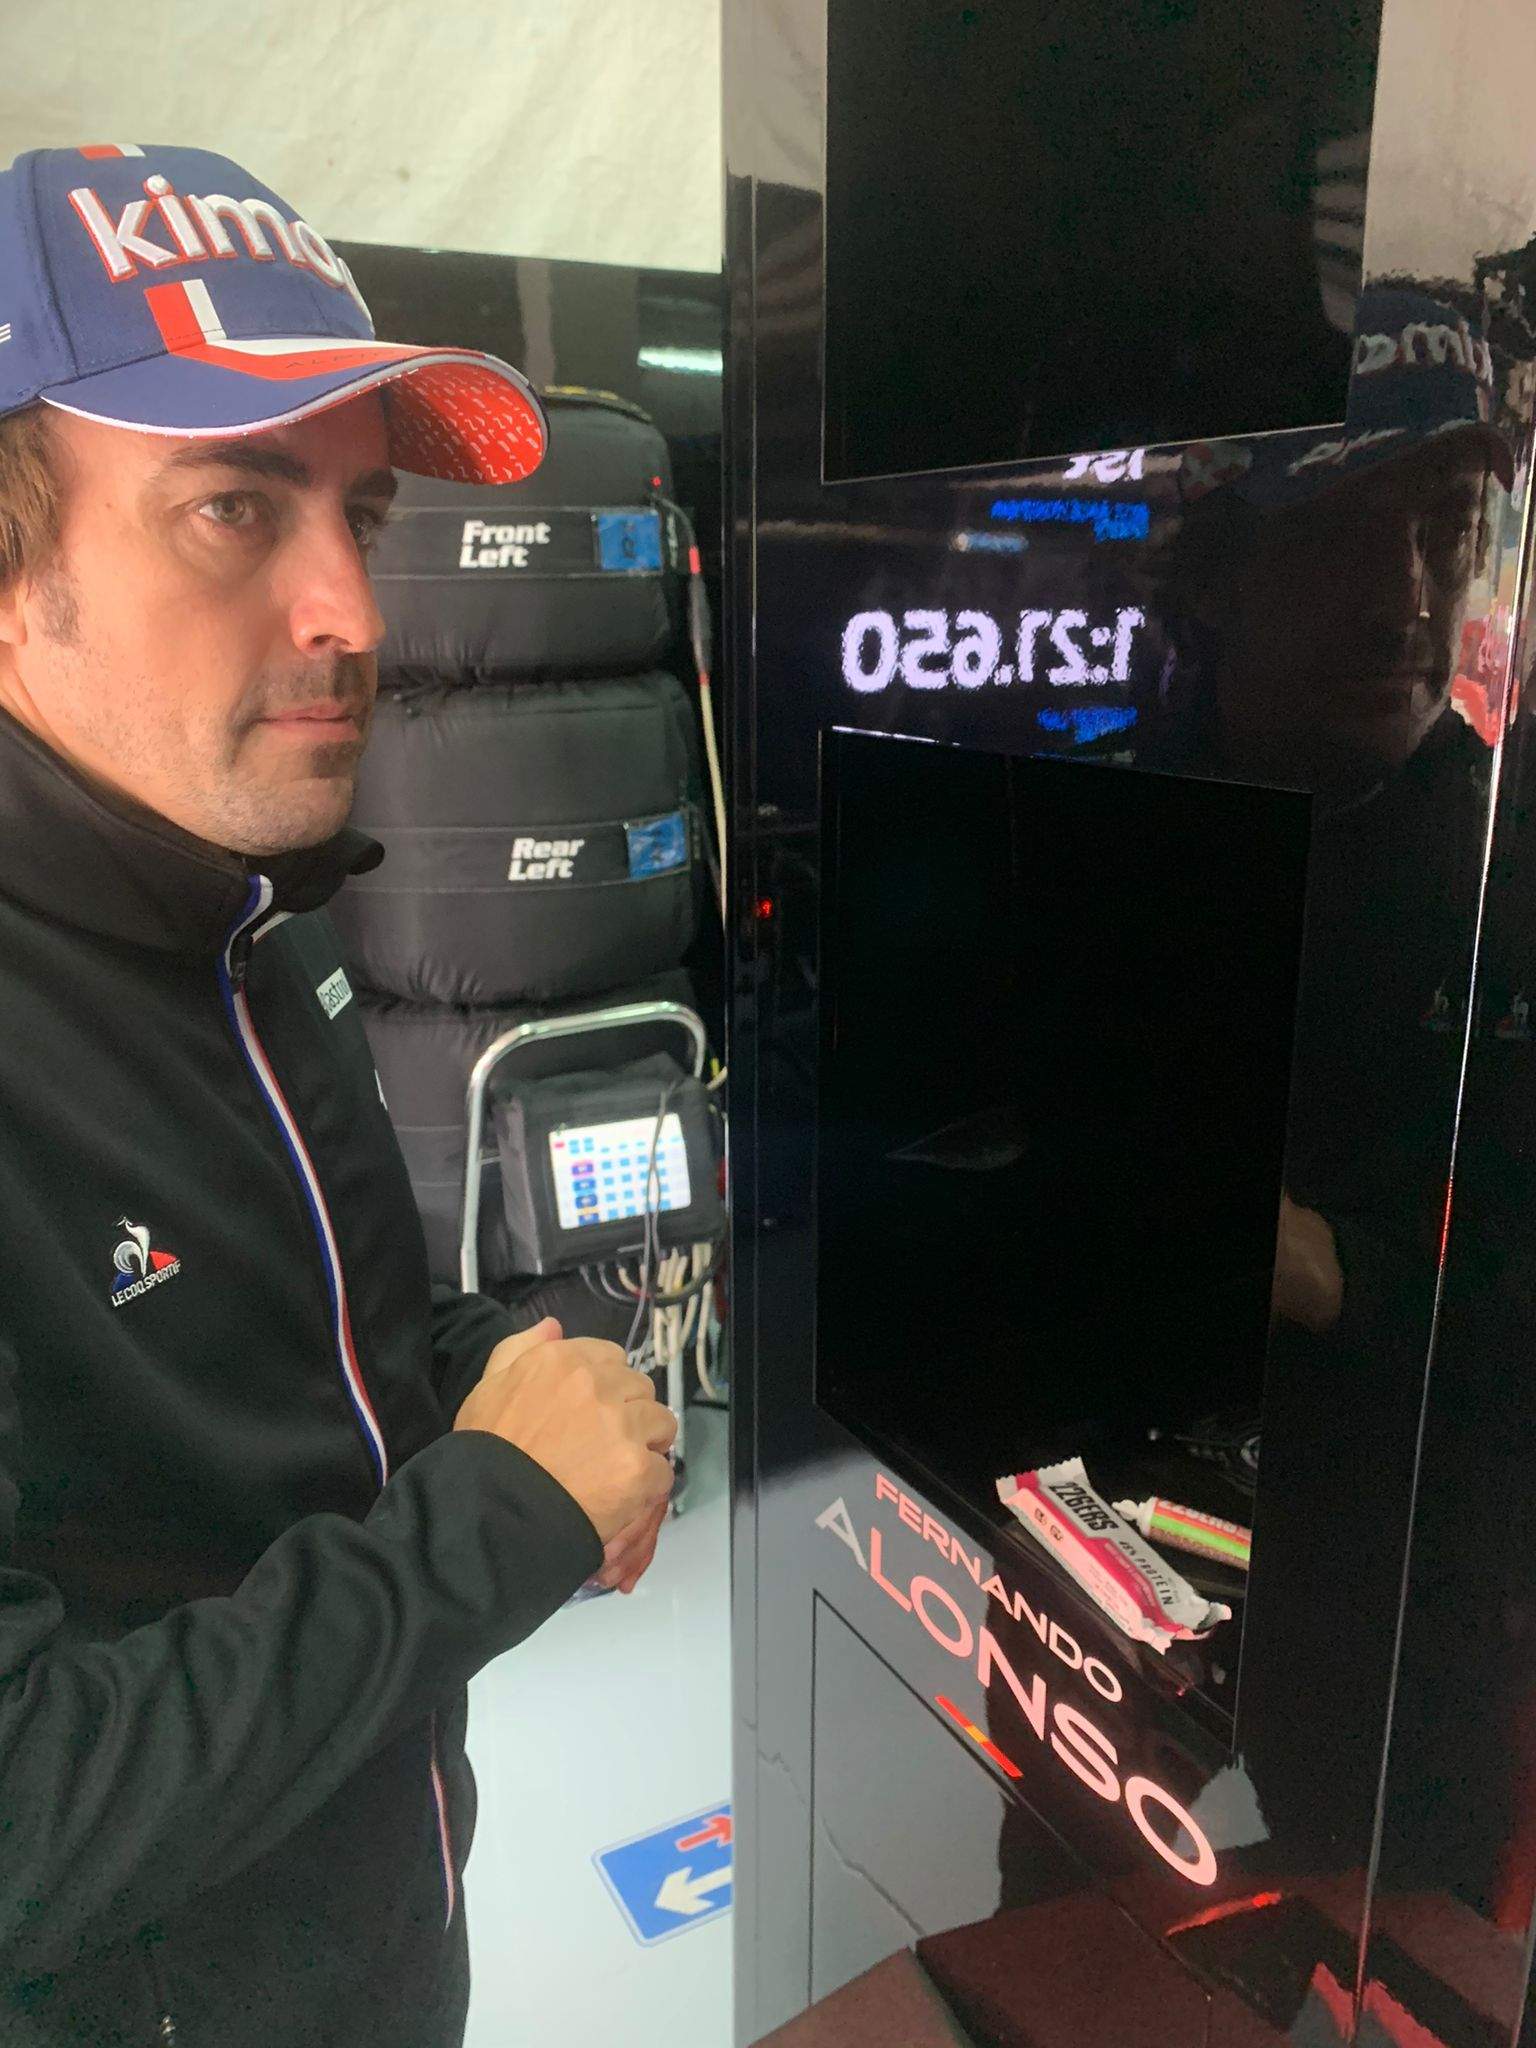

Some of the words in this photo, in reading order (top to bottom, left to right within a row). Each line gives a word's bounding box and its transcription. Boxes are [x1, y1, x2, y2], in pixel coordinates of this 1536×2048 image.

[67, 173, 372, 315] kimo
[461, 519, 551, 546] Front
[459, 543, 530, 568] Left
[511, 837, 585, 860] Rear
[507, 856, 575, 881] Left
[875, 1473, 1123, 1703] FERNANDO
[1135, 1557, 1175, 1606] PROTEIN
[815, 1496, 1218, 1887] ALONSO
